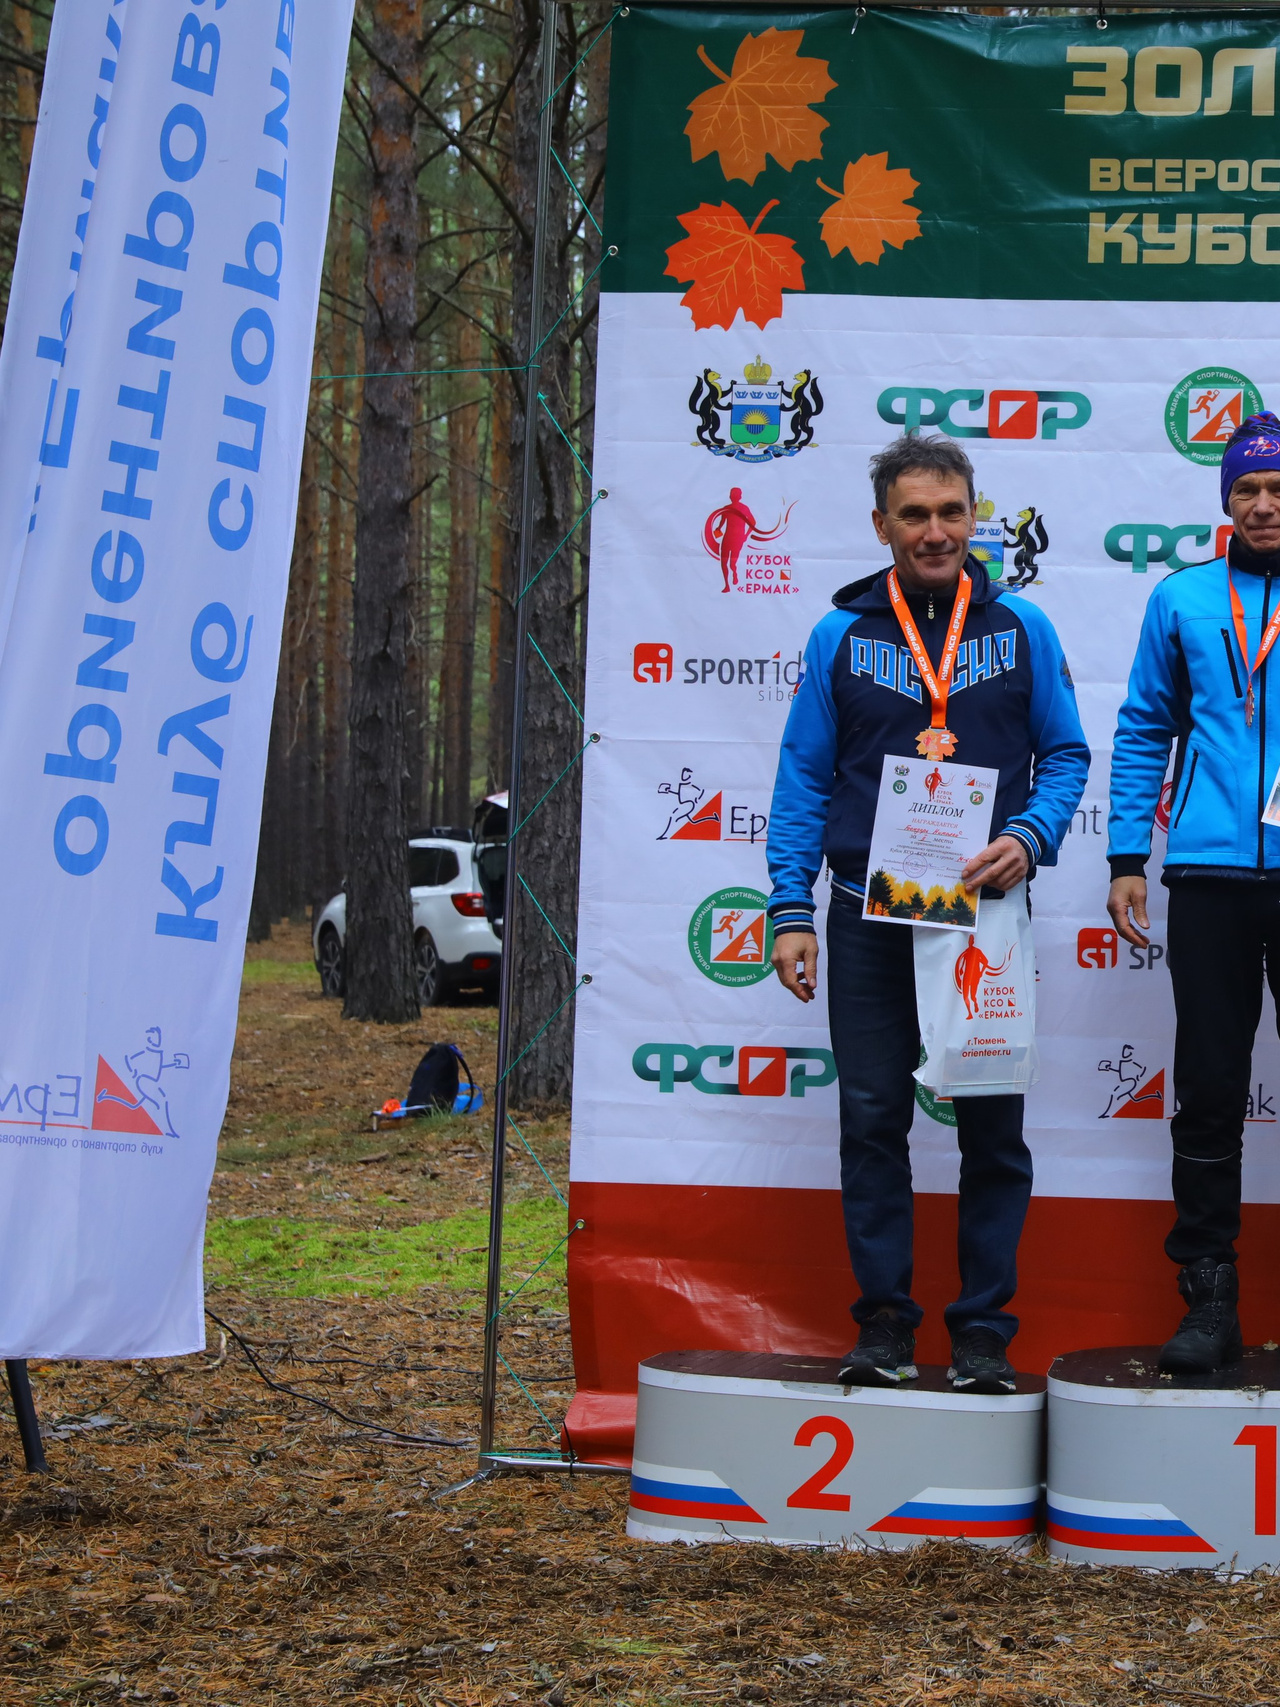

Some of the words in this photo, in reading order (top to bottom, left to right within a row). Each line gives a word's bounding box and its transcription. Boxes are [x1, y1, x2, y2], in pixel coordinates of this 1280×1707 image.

[1196, 371, 1246, 387] СПОРТИВНОГО
[746, 554, 792, 566] КУБОК
[746, 569, 775, 580] КСО
[737, 584, 800, 594] «ЕРМАК»
[684, 651, 802, 685] SPORTid
[940, 734, 951, 744] 2
[908, 802, 964, 818] ДИПЛОМ
[912, 818, 958, 828] НАГРАЖДАЕТСЯ
[693, 900, 717, 936] ФЕДЕРАЦИЯ
[693, 941, 710, 970] ОБЛАСТИ
[714, 971, 757, 982] ТЮМЕНСКОЙ
[984, 986, 1015, 996] КУБОК
[984, 998, 1004, 1007] КСО
[979, 1010, 1023, 1019] «ЕРМАК»
[967, 1037, 1006, 1046] г.Тюмень
[962, 1048, 1011, 1058] orienteer.ru
[787, 1415, 855, 1512] 2
[1233, 1425, 1277, 1536] 1
